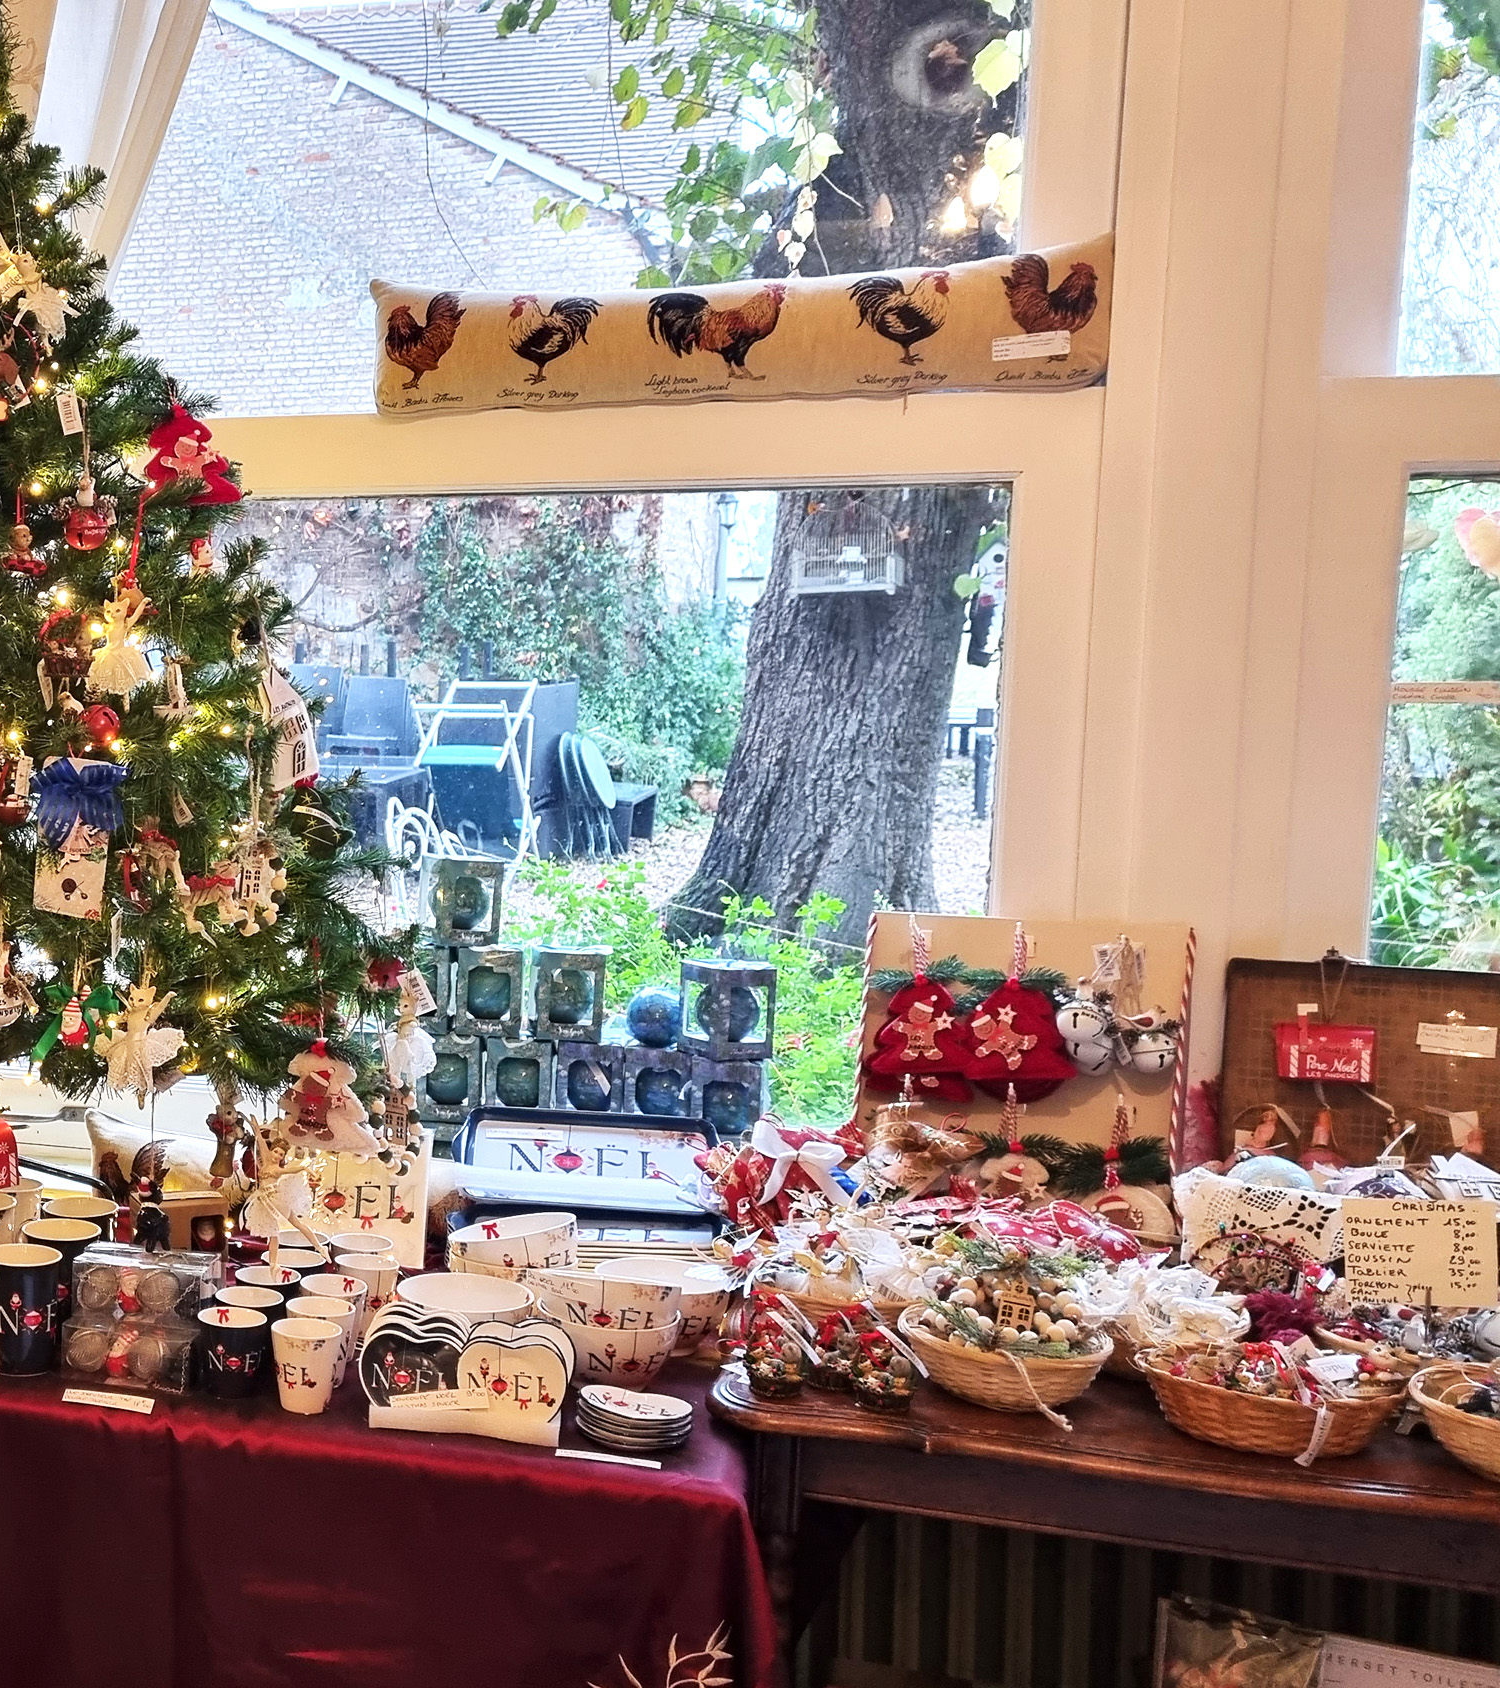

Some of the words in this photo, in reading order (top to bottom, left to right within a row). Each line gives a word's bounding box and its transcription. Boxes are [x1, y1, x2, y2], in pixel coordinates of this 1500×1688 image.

[857, 374, 890, 385] Silver
[891, 374, 912, 387] grey
[497, 388, 524, 398] Silver
[526, 391, 545, 402] grey
[1346, 1216, 1429, 1227] ORNEMENT
[1443, 1217, 1476, 1228] 15,00
[1453, 1229, 1476, 1241] 8,00
[1453, 1243, 1474, 1255] 8,00
[1348, 1253, 1411, 1264] COUSSIN
[1449, 1255, 1481, 1267] 29,00
[1448, 1268, 1482, 1280] 35,00
[1349, 1279, 1399, 1289] TORCHON
[1450, 1282, 1477, 1292] 15,00
[1350, 1288, 1380, 1296] GANT
[467, 1371, 554, 1403] NOËL
